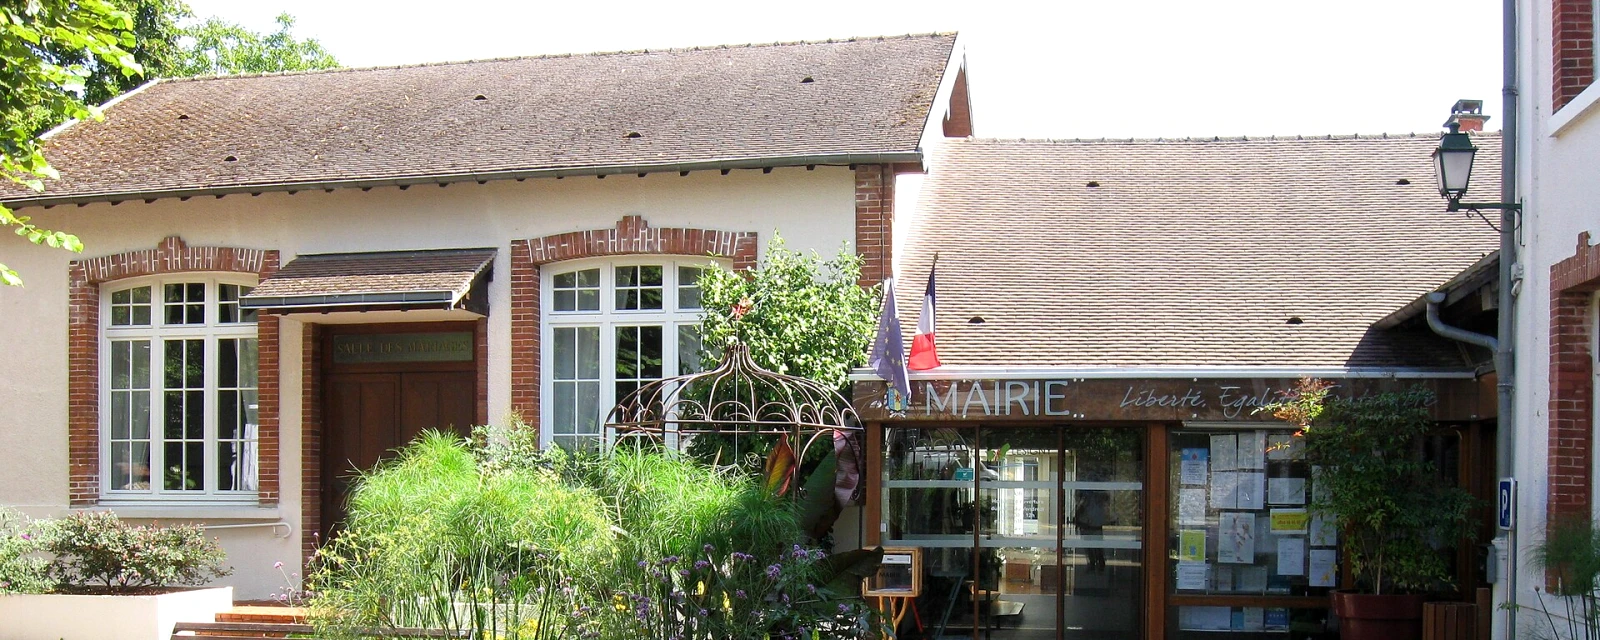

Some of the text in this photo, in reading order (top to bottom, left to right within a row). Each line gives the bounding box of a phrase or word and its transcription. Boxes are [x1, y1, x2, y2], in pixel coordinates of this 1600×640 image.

[337, 342, 372, 354] SALLE
[380, 341, 402, 353] DES
[926, 381, 1070, 416] MAIRIE
[1501, 488, 1508, 519] P
